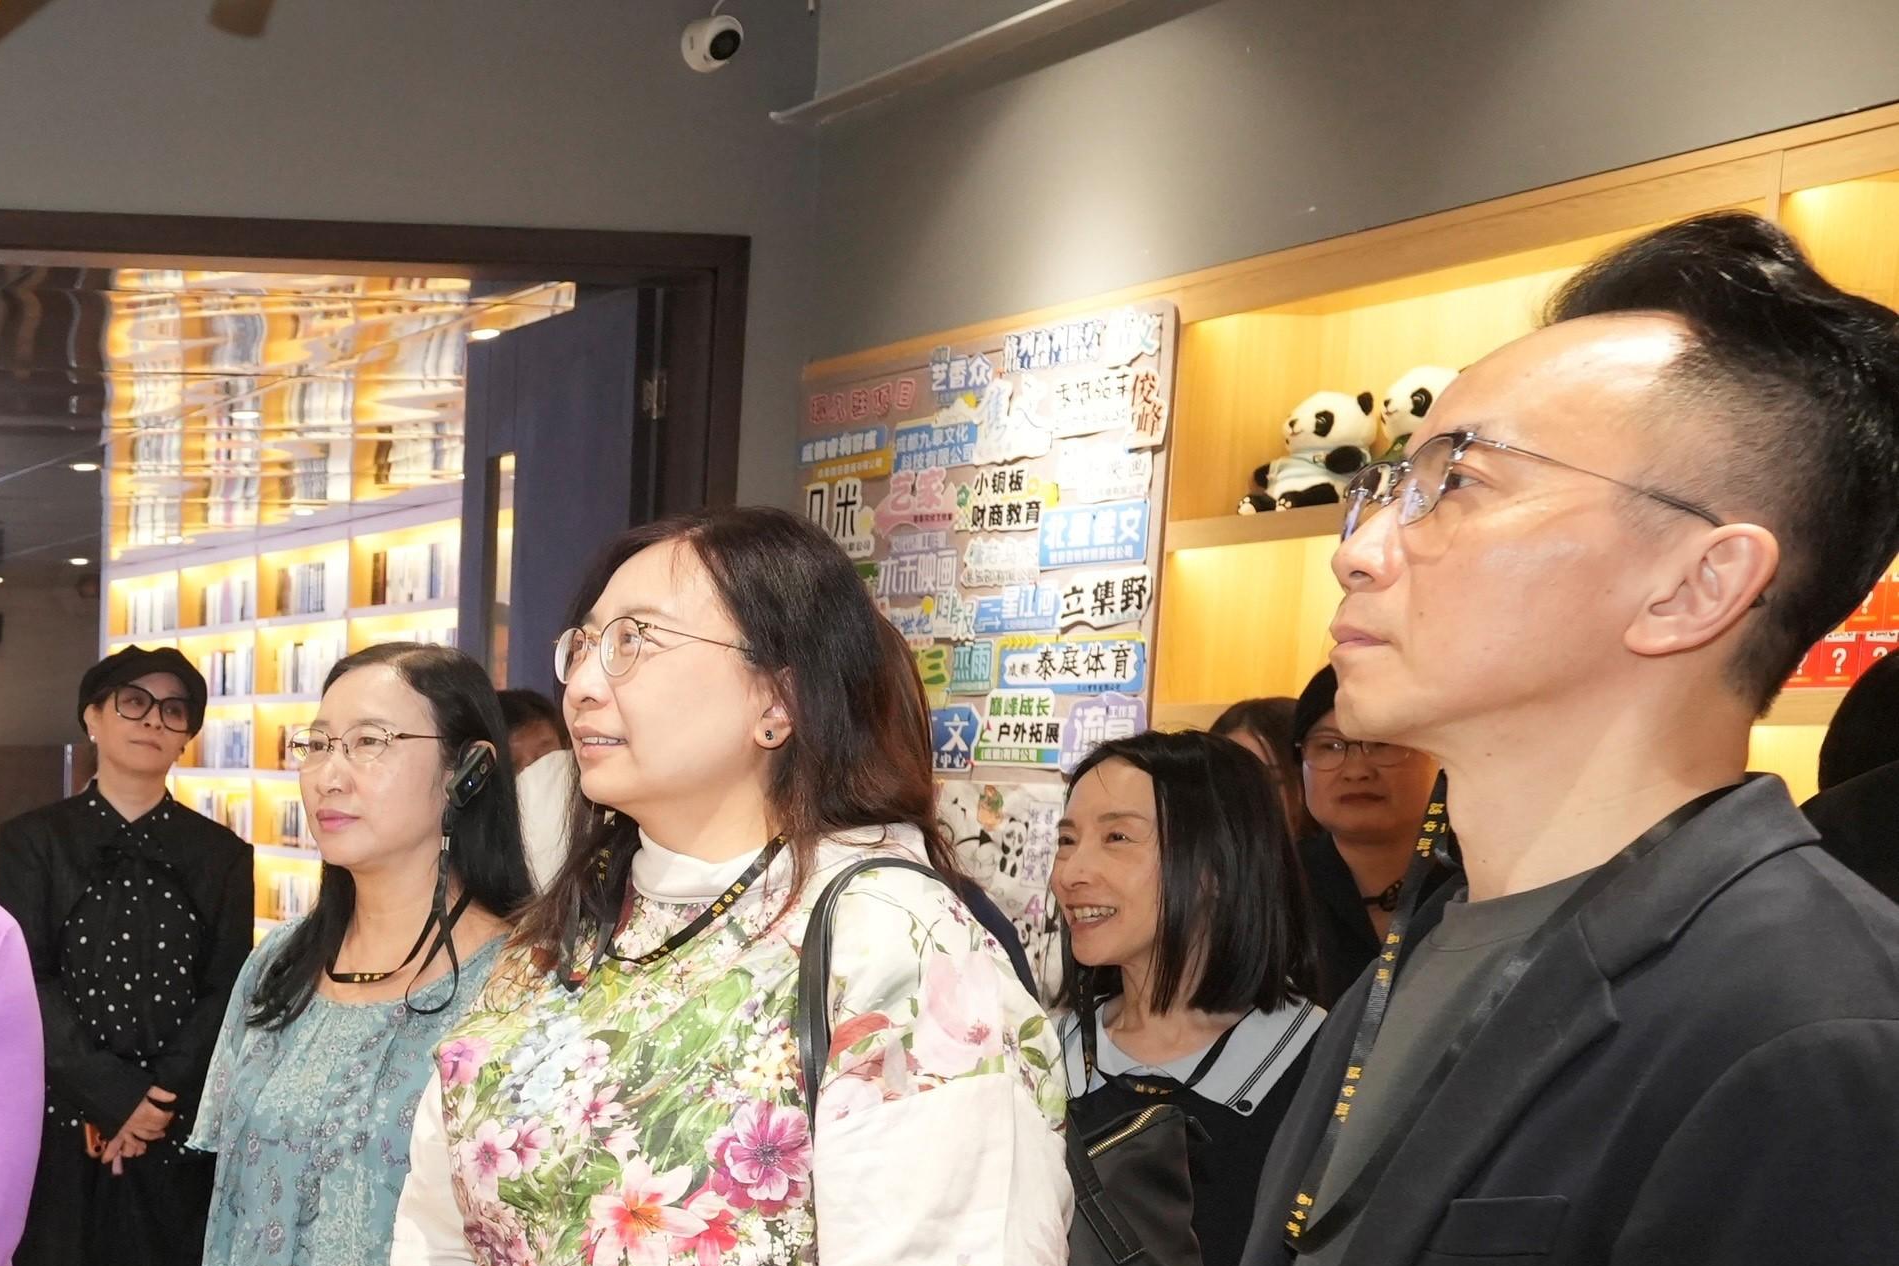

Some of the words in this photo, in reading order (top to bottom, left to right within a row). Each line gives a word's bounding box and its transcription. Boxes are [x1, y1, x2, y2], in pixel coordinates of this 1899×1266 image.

[971, 500, 1042, 528] 财商教育
[1035, 644, 1132, 681] 泰庭体育
[998, 722, 1060, 744] 户外拓展
